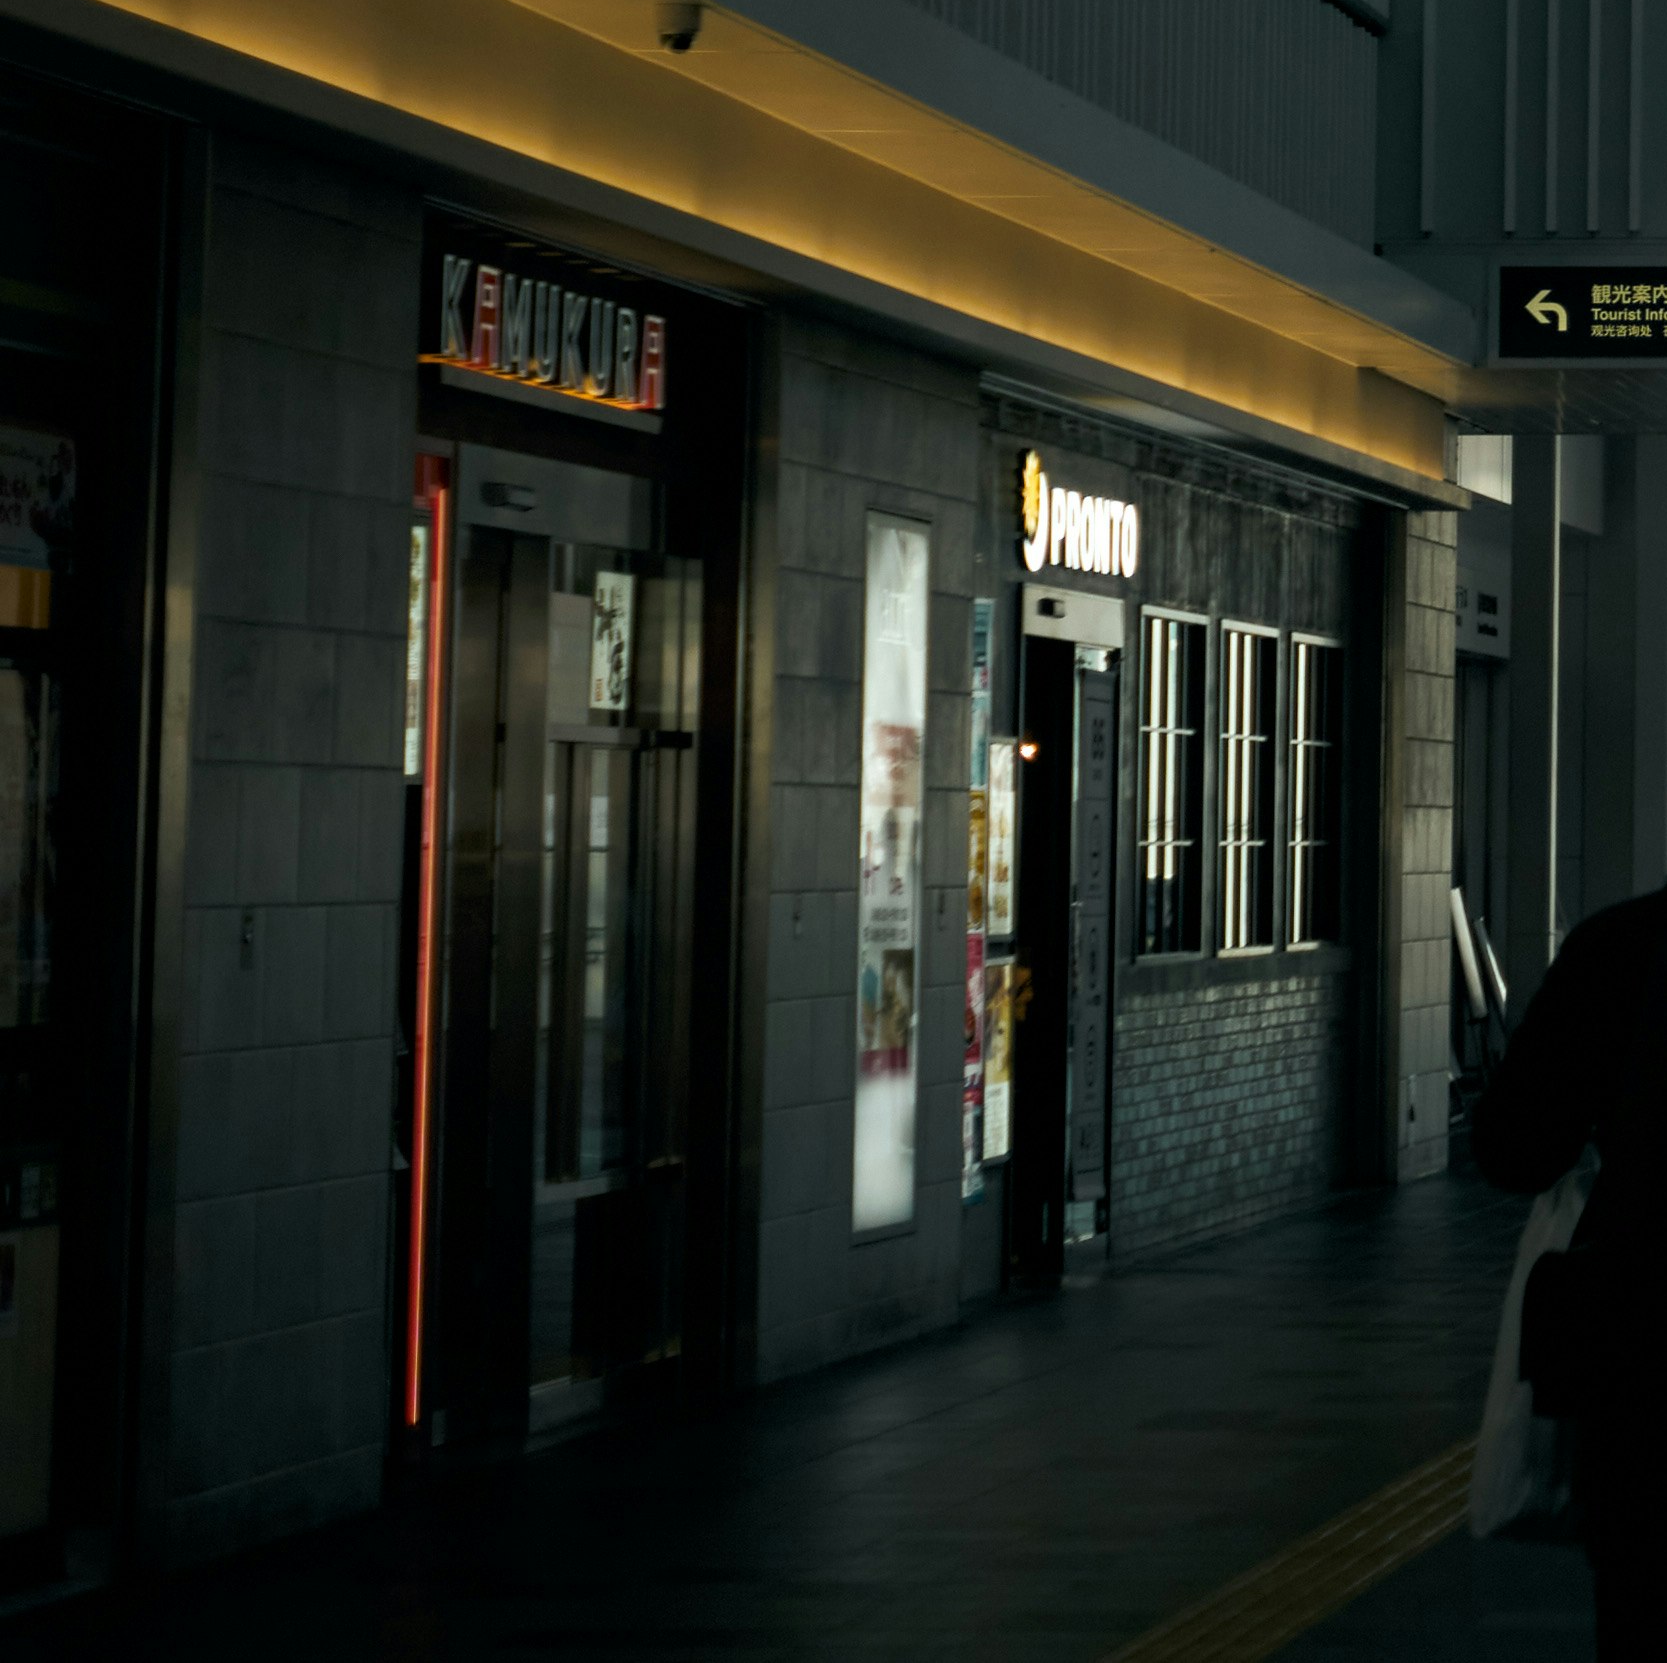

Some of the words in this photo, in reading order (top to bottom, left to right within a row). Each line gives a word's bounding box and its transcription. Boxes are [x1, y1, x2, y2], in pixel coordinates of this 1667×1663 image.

[441, 252, 668, 410] KAMUKURA
[1591, 308, 1642, 321] Tourist
[1591, 325, 1653, 338] 观光咨询处
[1050, 486, 1139, 579] PRONTO
